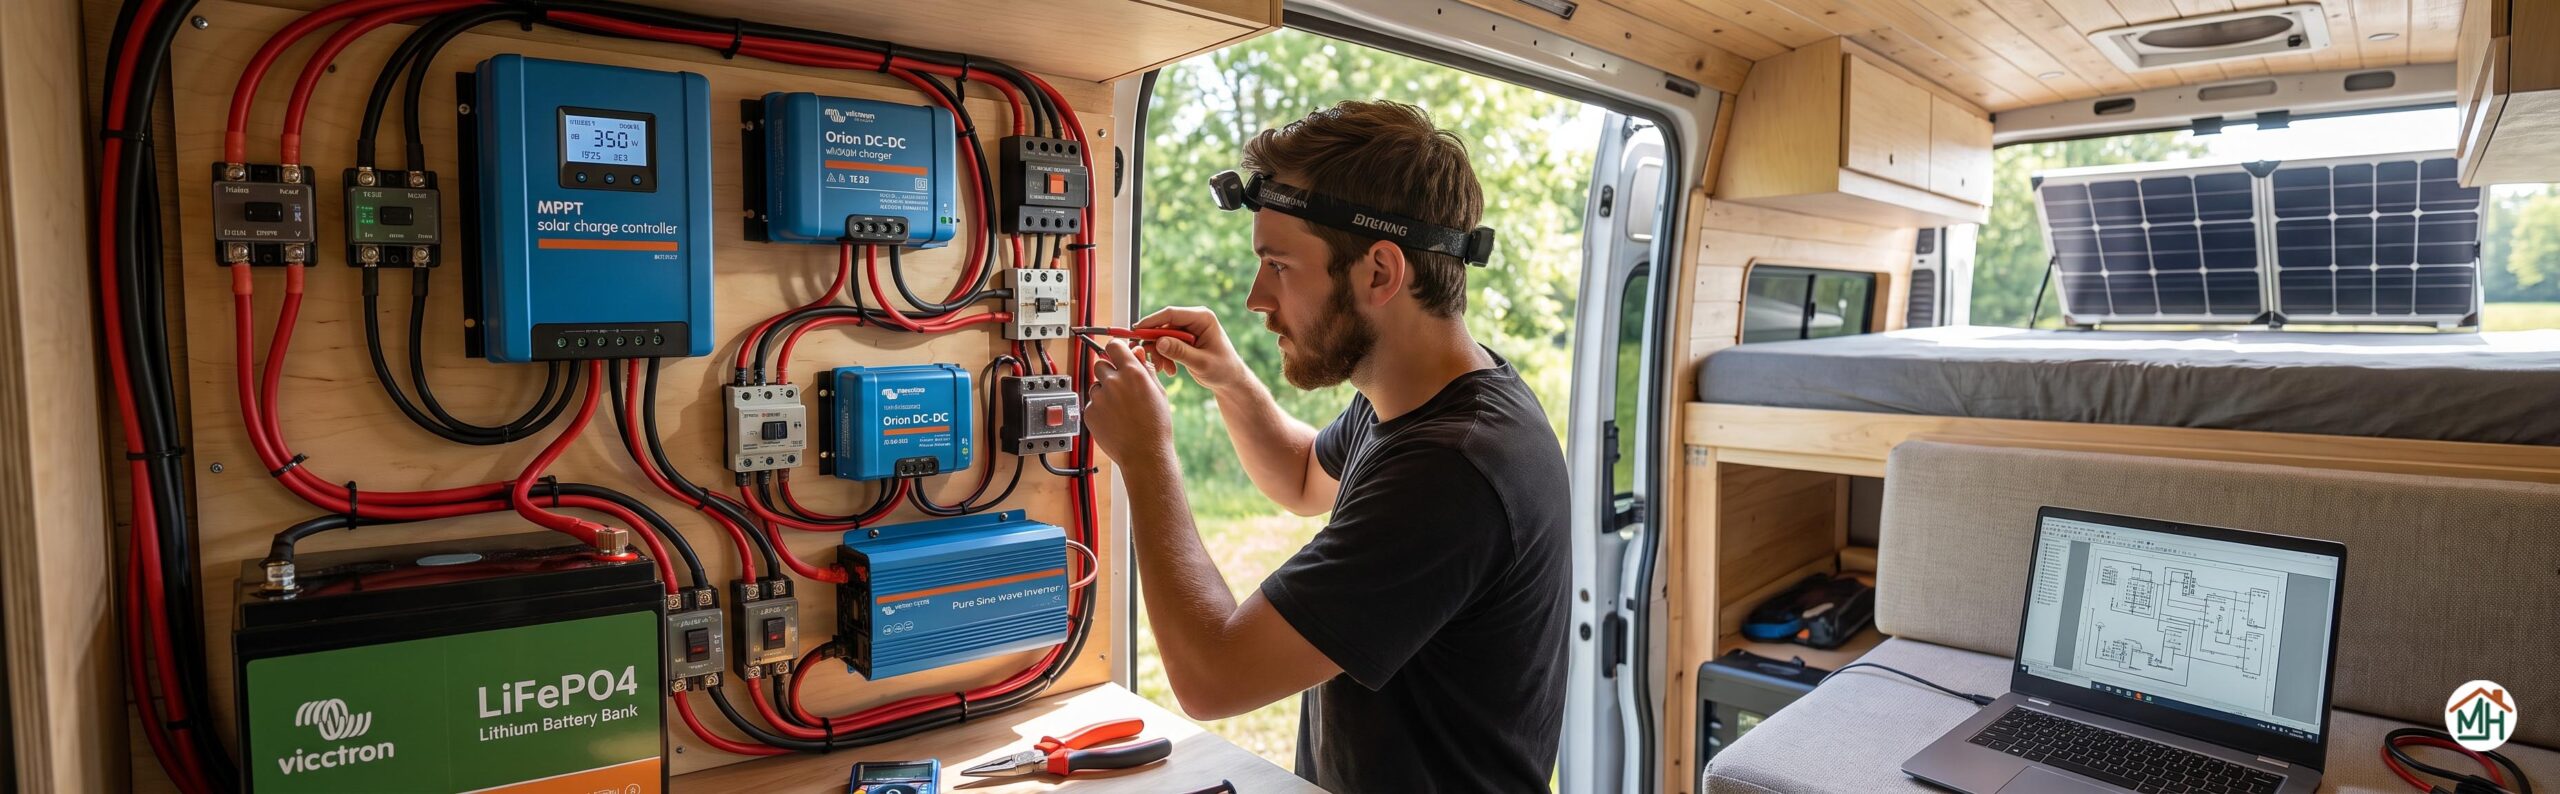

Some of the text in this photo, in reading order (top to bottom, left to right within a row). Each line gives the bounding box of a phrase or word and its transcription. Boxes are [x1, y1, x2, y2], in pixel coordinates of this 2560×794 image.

[594, 129, 628, 148] 350
[825, 131, 907, 149] Orion DC-DC
[858, 150, 892, 161] charger
[537, 200, 584, 215] MPPT
[537, 218, 677, 236] solar charge controller
[883, 412, 949, 426] Orion DC-DC
[952, 600, 975, 610] Pure
[976, 596, 997, 606] Sine
[478, 665, 638, 719] LiFePO4
[479, 704, 638, 742] Lithium Battery Bank
[278, 741, 395, 775] vicctron
